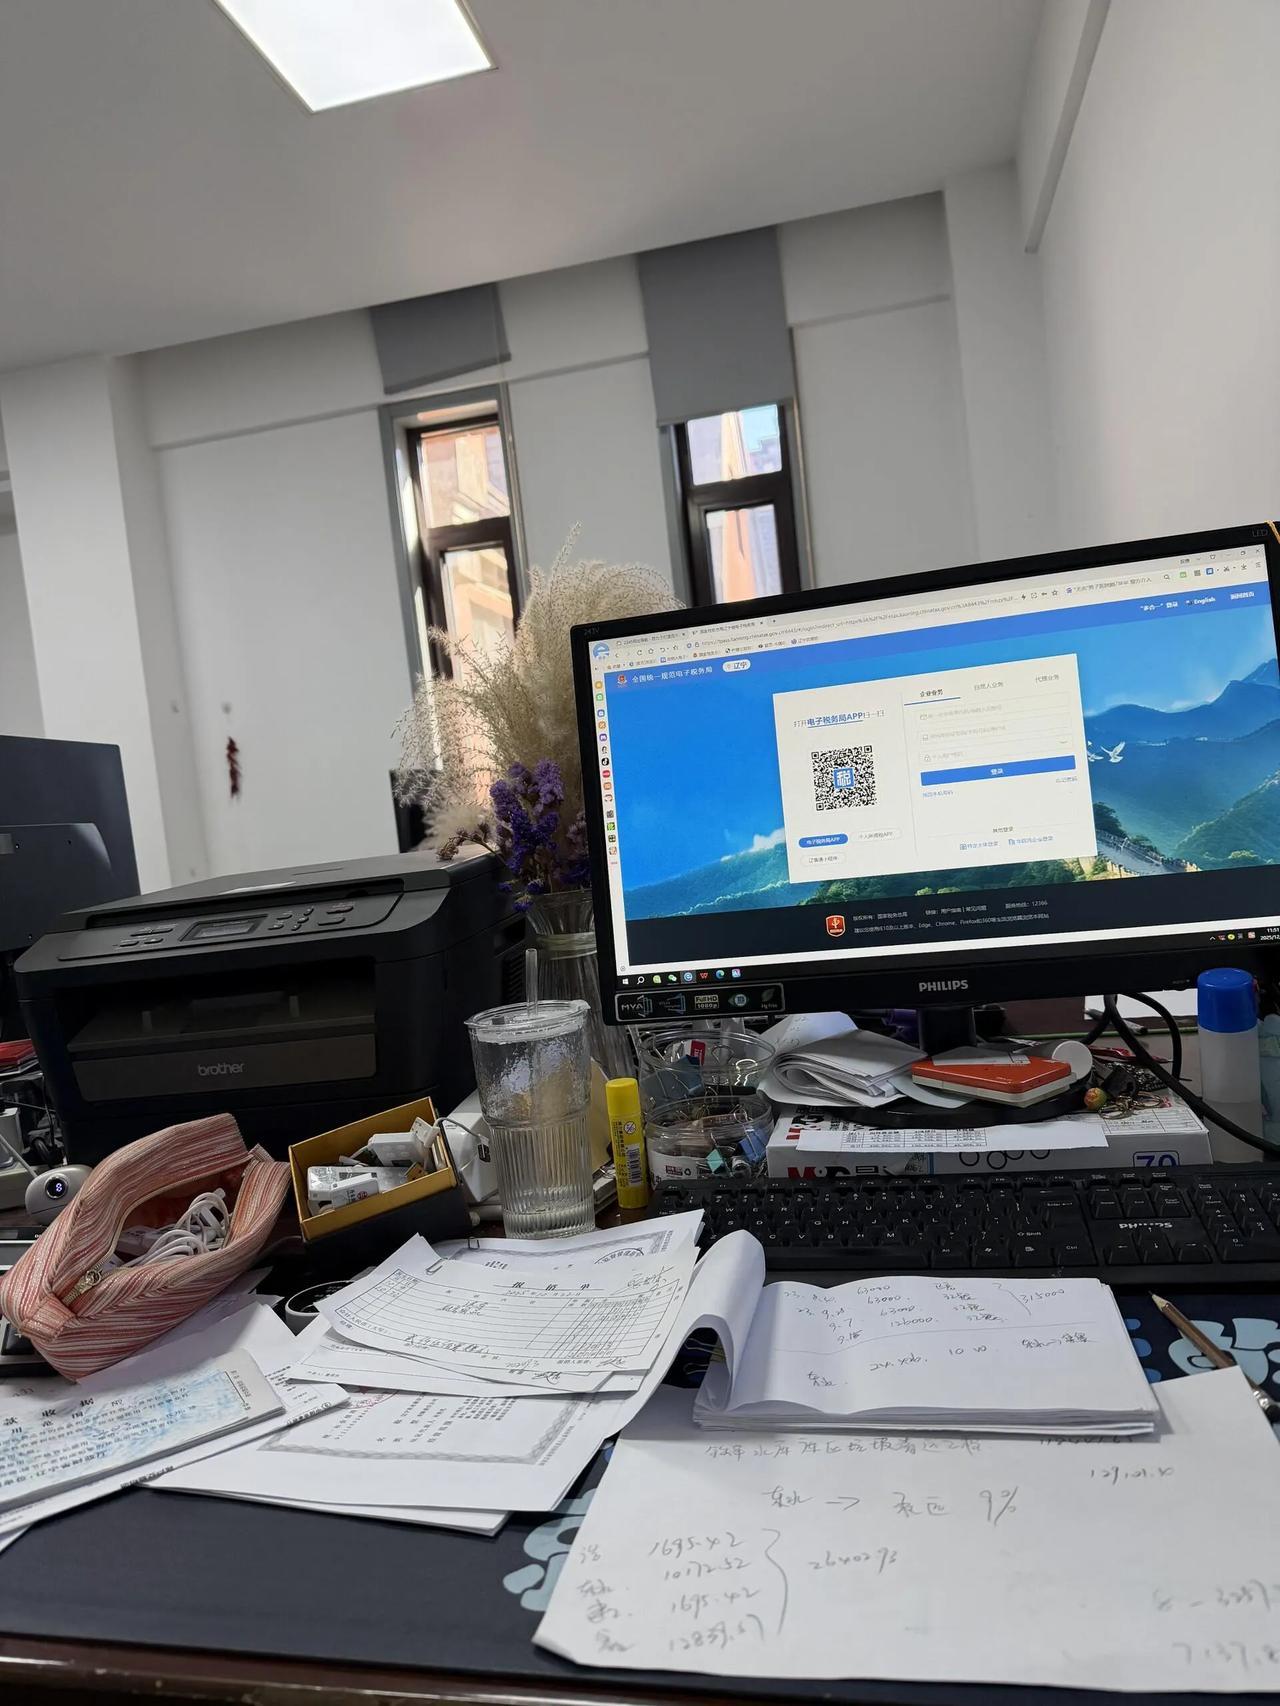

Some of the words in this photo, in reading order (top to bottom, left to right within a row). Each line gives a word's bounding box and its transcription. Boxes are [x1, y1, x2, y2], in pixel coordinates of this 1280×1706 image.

[1193, 597, 1216, 606] English
[733, 661, 748, 670] 辽宁
[631, 666, 713, 683] 全国统一规范电子税务局
[918, 979, 969, 992] PHILIPS
[197, 1061, 245, 1077] brother
[979, 1485, 1019, 1526] 9%
